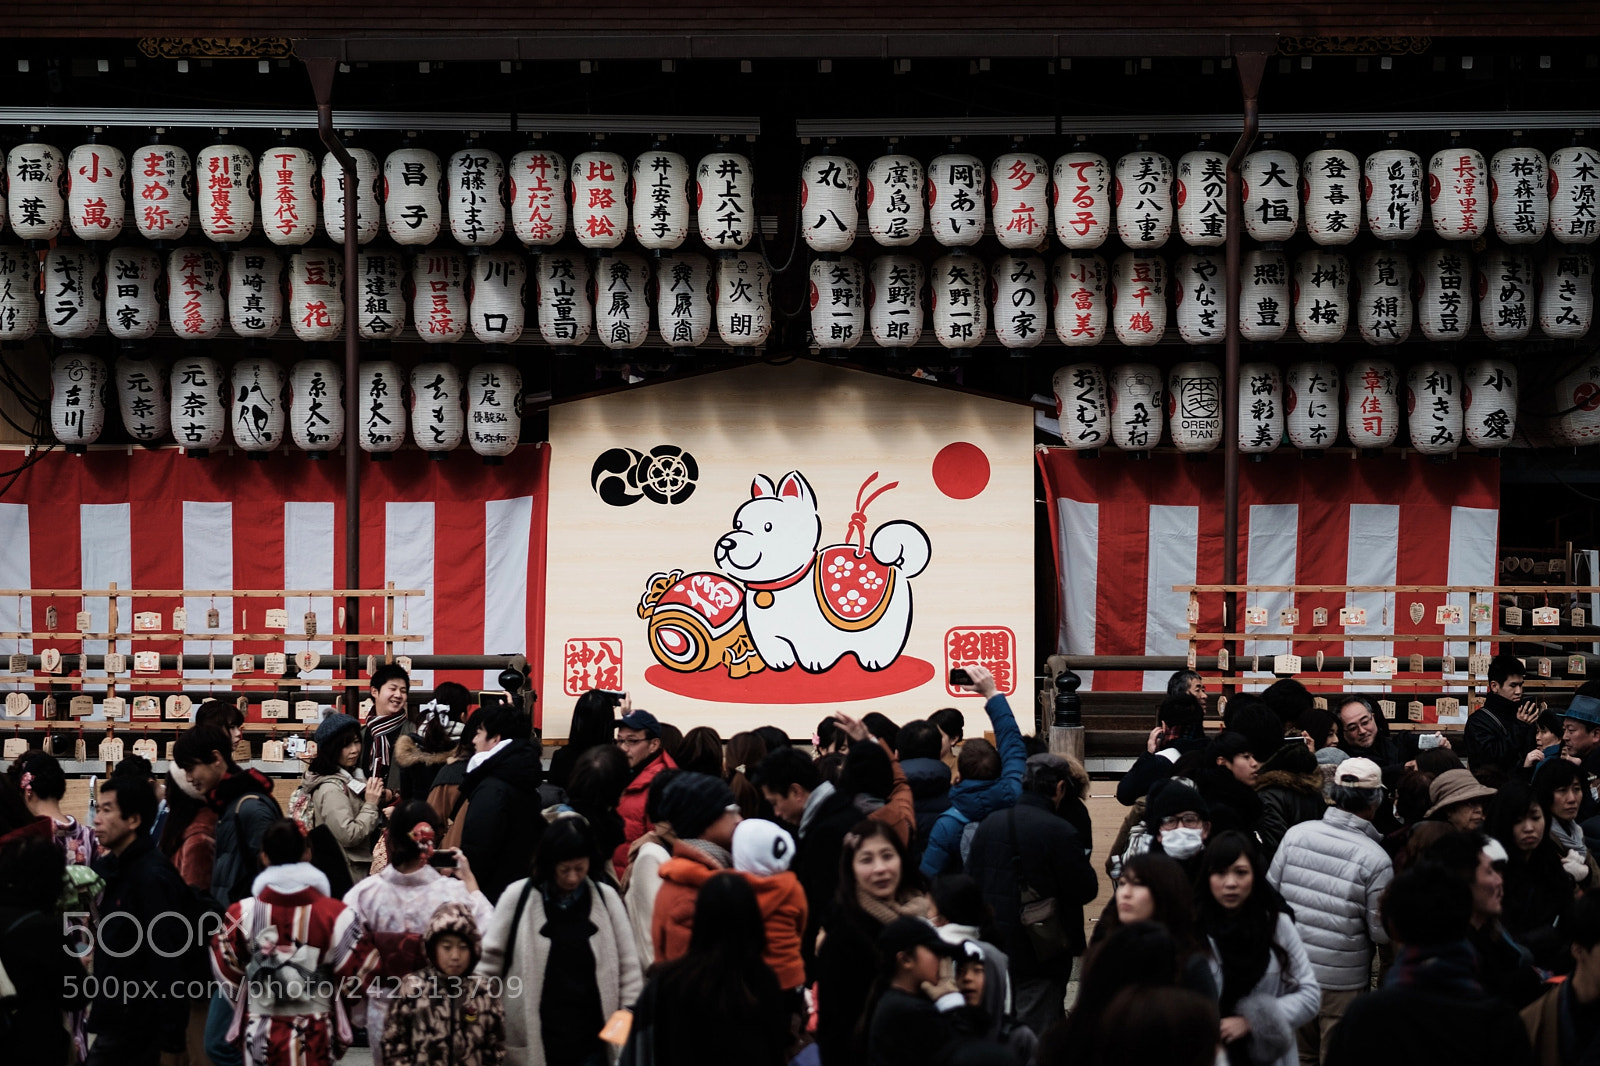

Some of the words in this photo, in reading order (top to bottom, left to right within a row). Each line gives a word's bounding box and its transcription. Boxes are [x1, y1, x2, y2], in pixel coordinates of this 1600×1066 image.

[16, 157, 46, 226] 福葉
[79, 152, 113, 229] 小萬
[141, 152, 173, 230] まめ弥
[165, 150, 176, 188] 祇園甲部
[232, 154, 243, 189] 祇園甲部
[274, 154, 299, 236] 下里香代子
[401, 162, 428, 229] 昌子
[459, 154, 489, 243] 加藤小ます
[586, 160, 616, 238] 比路松
[651, 156, 672, 238] 井上安寿子
[715, 159, 745, 245] 井上八千代
[813, 161, 847, 232] 丸八
[884, 161, 911, 239] 廣島屋
[949, 164, 976, 234] 岡あい
[1006, 159, 1038, 236] 多麻
[1069, 161, 1098, 236] てる子
[1133, 156, 1164, 241] 美の八重
[1199, 158, 1227, 238] 美の八重
[1256, 162, 1293, 224] 大恒
[1320, 156, 1351, 233] 登喜家
[1452, 156, 1478, 235] 長澤里美
[1510, 156, 1537, 235] 祐森正哉
[1568, 152, 1600, 237] 八木源太郎
[53, 255, 79, 326] キメラ
[115, 258, 141, 330] 池田家
[242, 256, 266, 330] 田崎真也
[302, 260, 331, 328] 豆花
[365, 256, 392, 333] 用達組合
[427, 257, 454, 335] 川口豆涼
[483, 261, 509, 333] 川口
[550, 258, 578, 340] 茂山童司
[729, 277, 753, 336] 次朗
[829, 265, 853, 342] 矢野一郎
[886, 265, 911, 339] 矢野一郎
[947, 265, 973, 342] 矢野一郎
[1010, 261, 1037, 339] みの家
[1070, 264, 1096, 338] 小富美
[1129, 263, 1154, 334] 豆千鶴
[1253, 263, 1281, 327] 照豊
[1309, 264, 1340, 325] 桝梅
[1371, 257, 1401, 339] 筧絹代
[1437, 256, 1463, 333] 柴田芳豆
[1498, 259, 1528, 330] まめ蝶
[1556, 256, 1581, 326] 岡きみ
[65, 384, 85, 438] 吉川
[127, 373, 154, 440] 元奈古
[180, 365, 208, 442] 元奈古
[479, 373, 501, 407] 北尾
[1073, 369, 1101, 443] おくむら
[1181, 420, 1220, 430] ORENO
[1250, 373, 1275, 447] 満彩美
[1308, 373, 1328, 445] たに本
[1360, 367, 1385, 437] 章佳司
[1424, 370, 1454, 446] 利きみ
[1482, 368, 1513, 440] 小愛
[1190, 429, 1214, 439] PAN
[566, 641, 592, 693] 神社
[592, 641, 622, 691] 八坂
